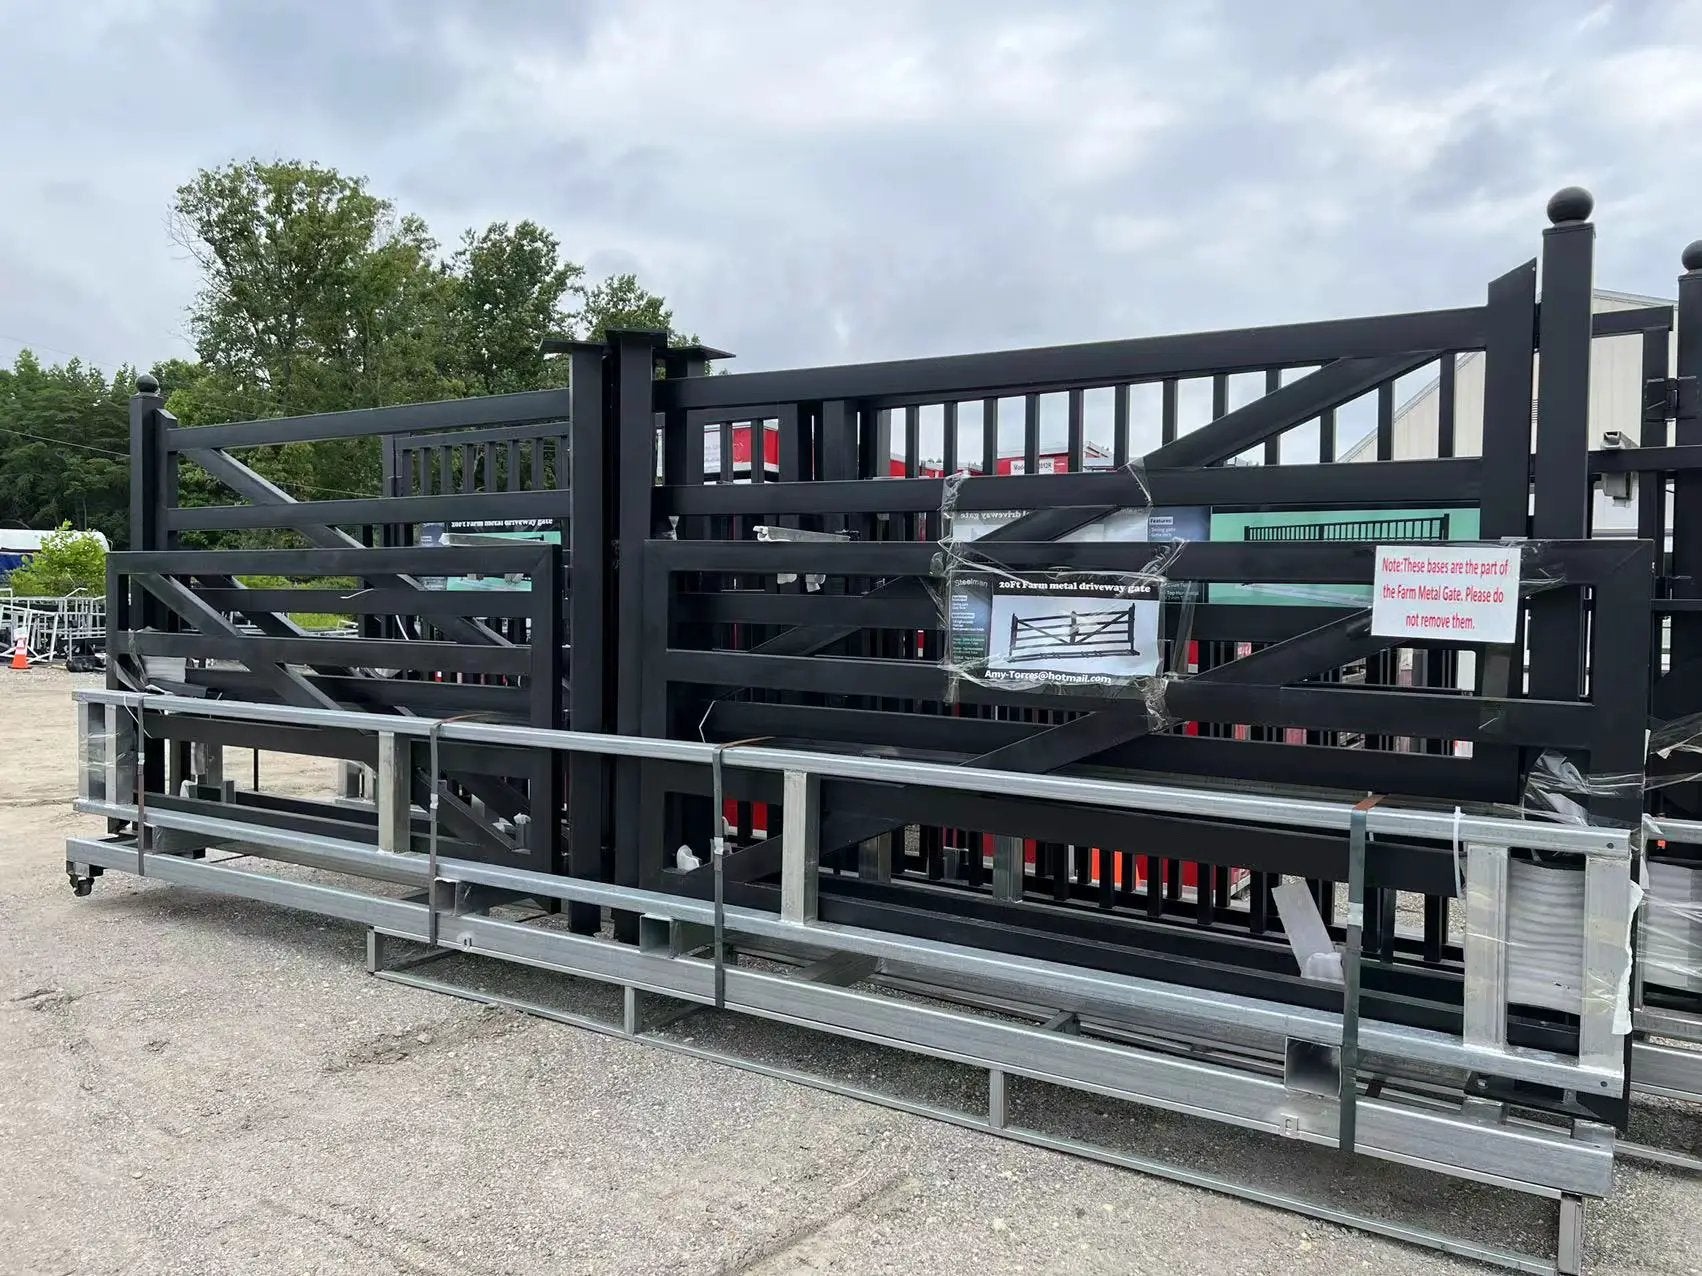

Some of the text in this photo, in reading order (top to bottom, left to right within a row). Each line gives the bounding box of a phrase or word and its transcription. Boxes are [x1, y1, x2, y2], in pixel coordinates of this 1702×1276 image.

[1427, 558, 1449, 574] bases
[1450, 562, 1464, 574] are
[1465, 559, 1480, 574] the
[1481, 561, 1497, 579] part
[1499, 559, 1509, 575] of
[954, 578, 988, 588] Steelman
[998, 581, 1151, 595] 20Ft Farm metal driveway gate
[1383, 584, 1504, 603] the Farm Metal Gate. Please do
[1405, 613, 1475, 630] not remove them.
[984, 670, 1112, 684] Amy-Torres@hotmail.com
